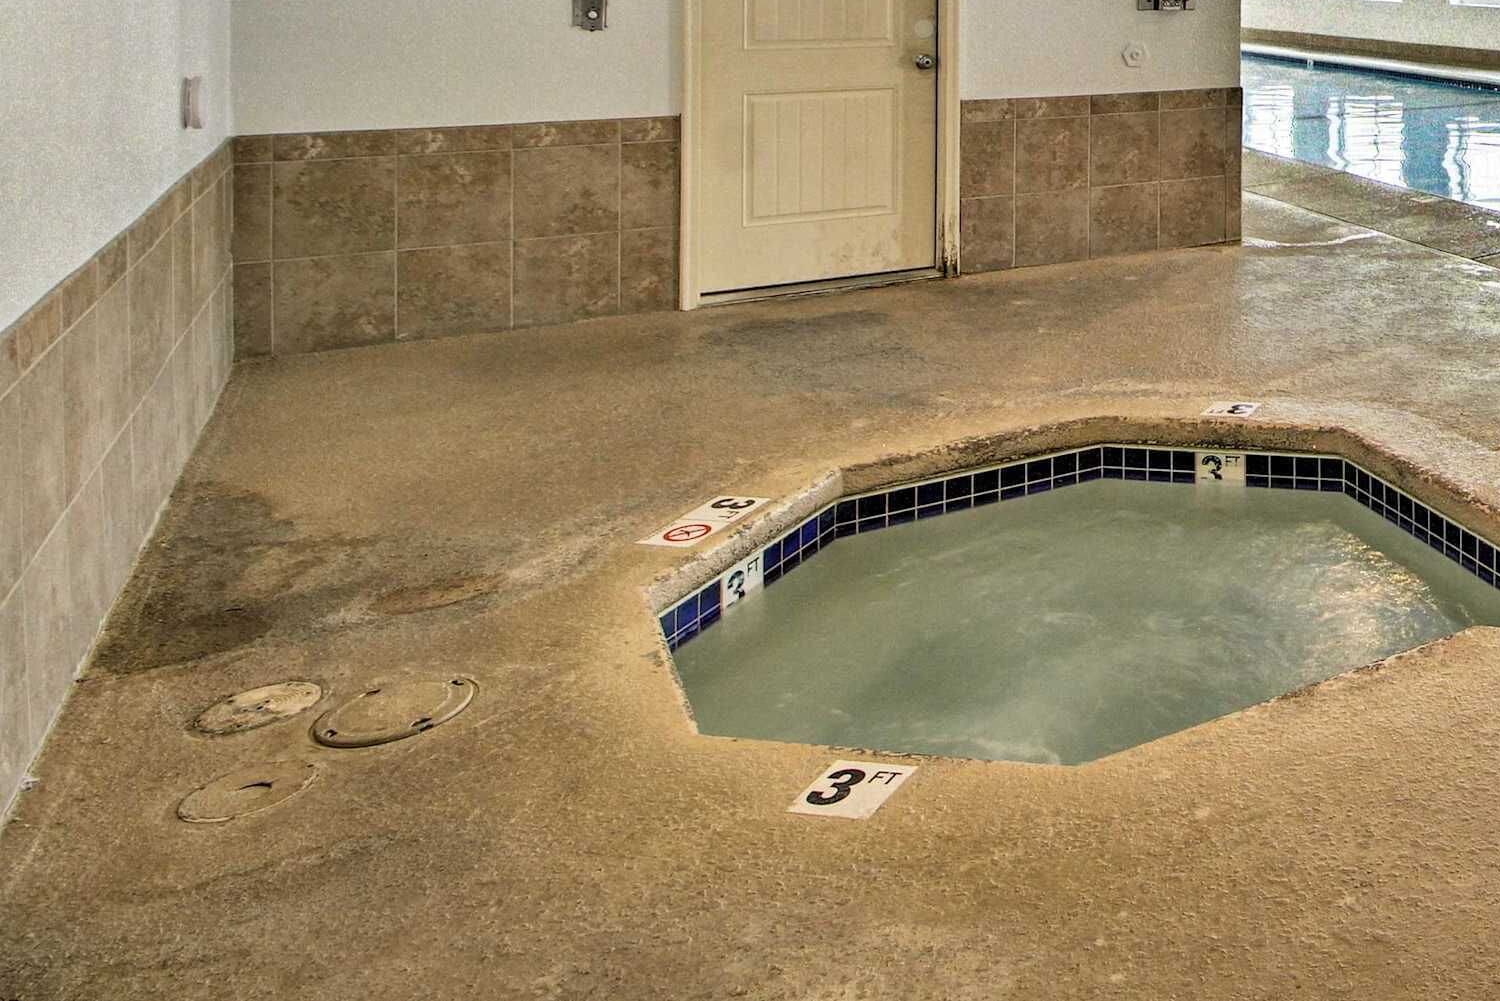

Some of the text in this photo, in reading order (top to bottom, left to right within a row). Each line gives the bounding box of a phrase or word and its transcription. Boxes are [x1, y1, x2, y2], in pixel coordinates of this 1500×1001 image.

[1225, 455, 1240, 467] FT
[711, 498, 756, 520] 3 FT
[747, 556, 760, 577] FT
[806, 769, 902, 805] 3 FT
